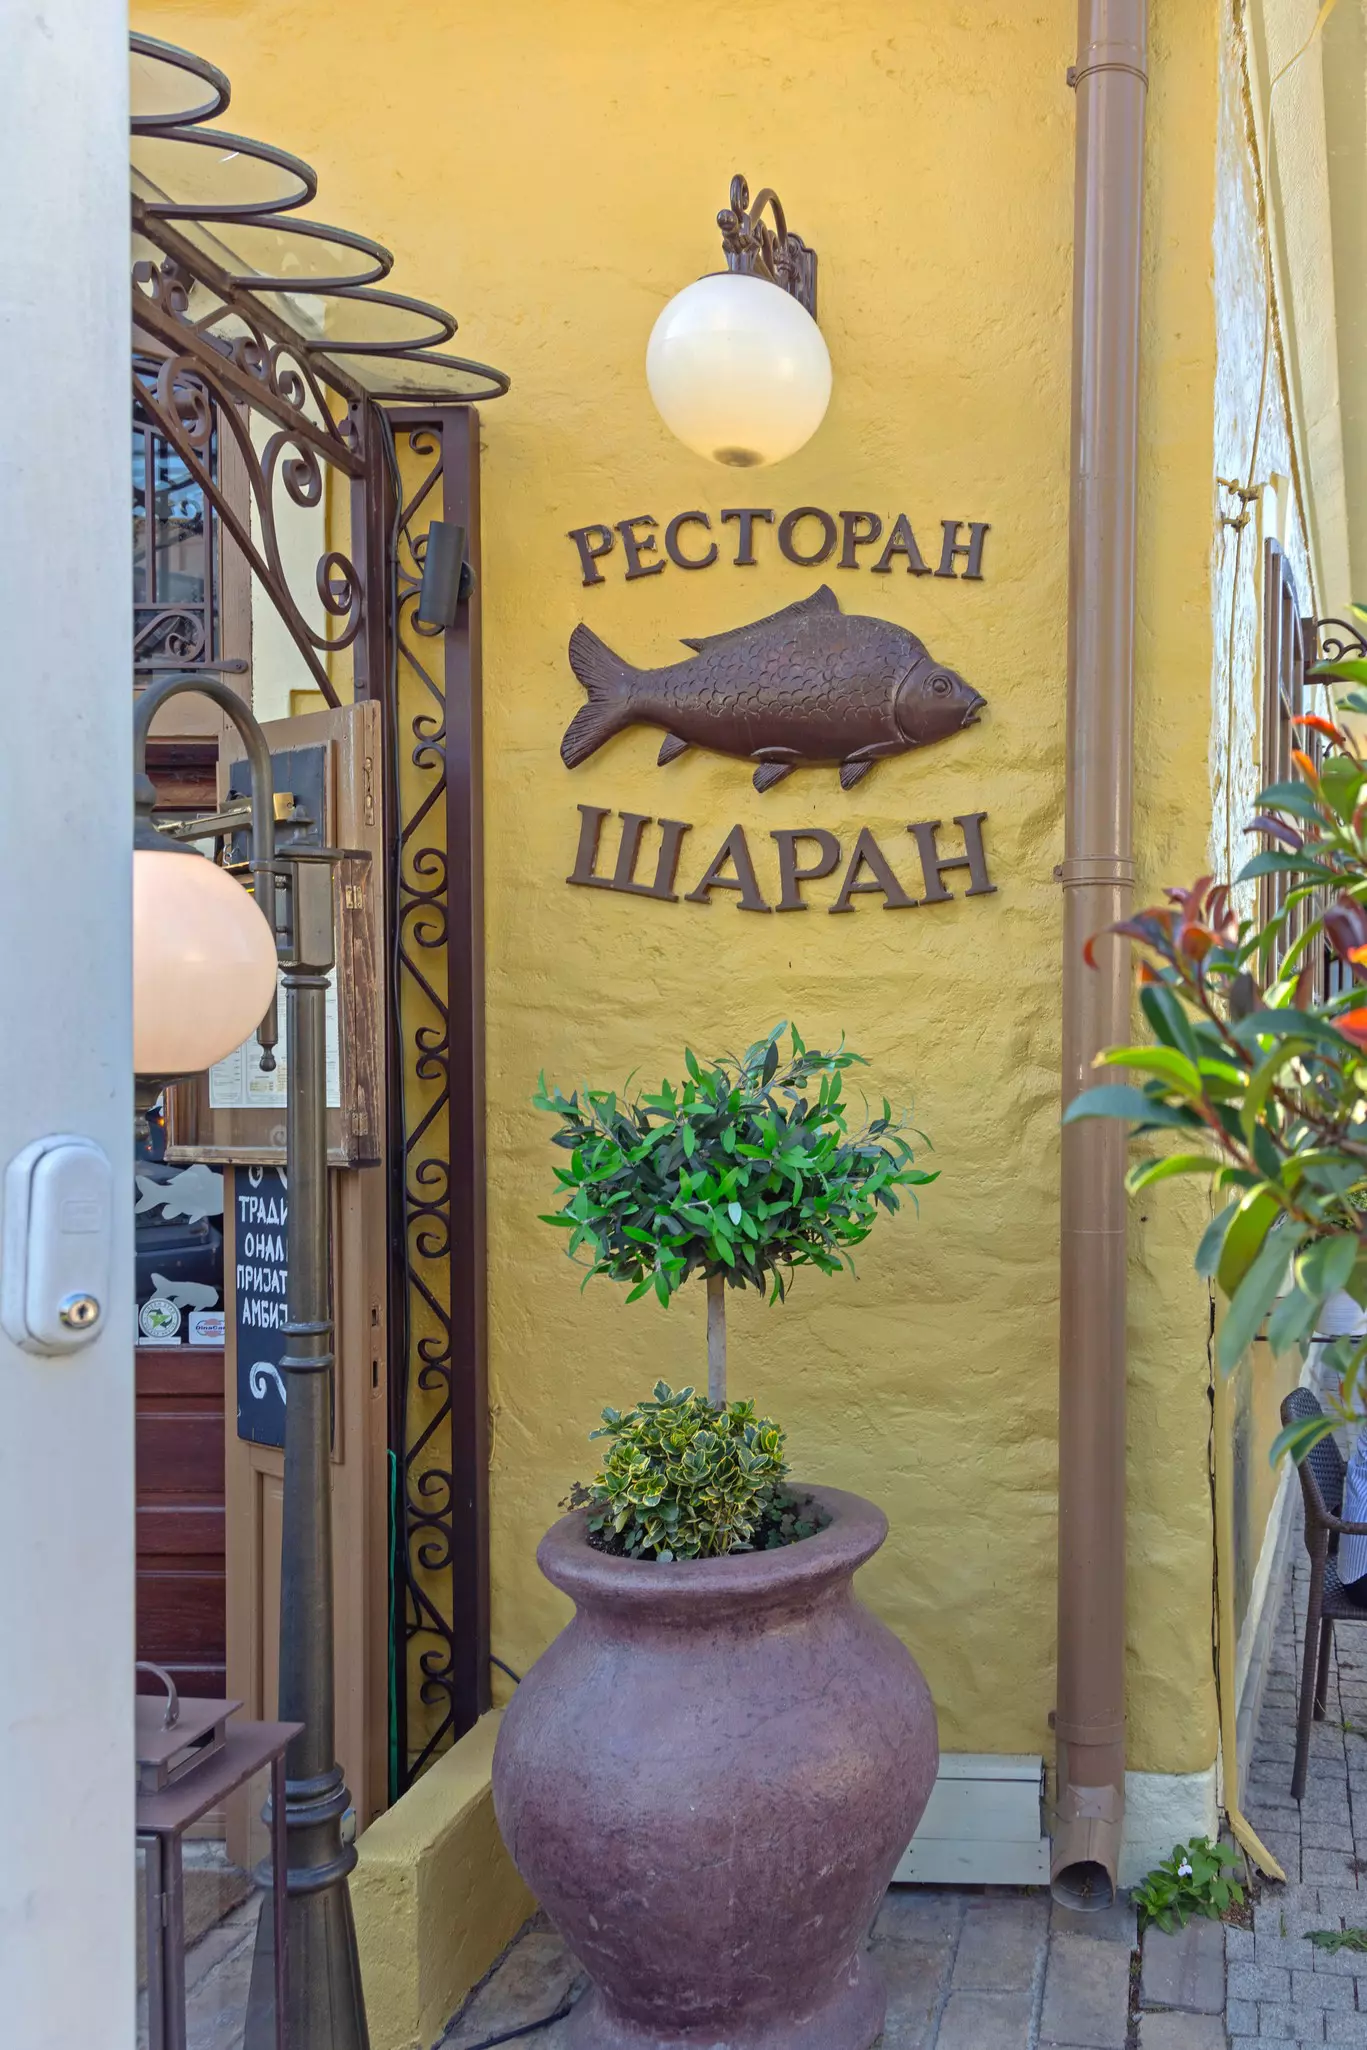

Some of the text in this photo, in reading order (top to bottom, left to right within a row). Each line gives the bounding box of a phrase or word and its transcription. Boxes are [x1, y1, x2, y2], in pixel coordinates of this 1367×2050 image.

[567, 507, 991, 586] РЕСТОРАН
[566, 803, 998, 914] ШАРАН
[238, 1195, 288, 1226] ТРАДИ
[244, 1232, 288, 1262] ОНАЛ
[236, 1264, 288, 1295] ПРИЈАТ
[242, 1296, 288, 1330] АМБИЈ
